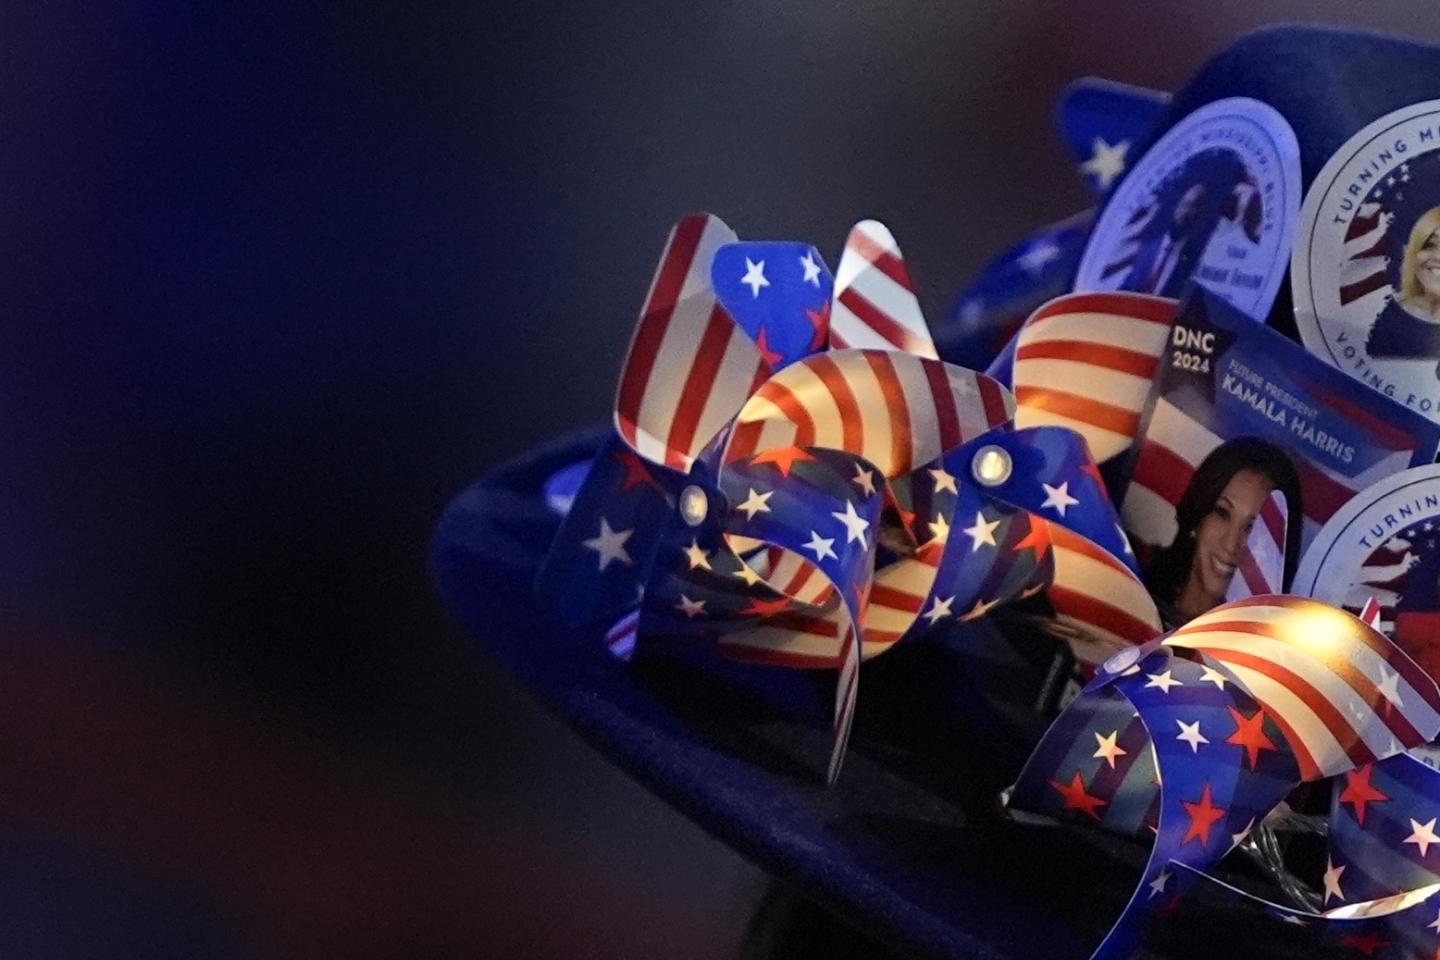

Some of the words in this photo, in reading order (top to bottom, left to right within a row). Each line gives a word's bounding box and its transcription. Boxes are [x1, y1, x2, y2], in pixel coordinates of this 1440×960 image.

[1334, 140, 1408, 226] TURNING
[1172, 350, 1211, 373] 2024
[1173, 325, 1215, 353] DNC
[1335, 331, 1397, 398] VOTING
[1222, 374, 1286, 427] KAMALA
[1290, 417, 1356, 463] HARRIS
[1229, 358, 1264, 388] FUTURE
[1265, 381, 1319, 421] PRESIDENT
